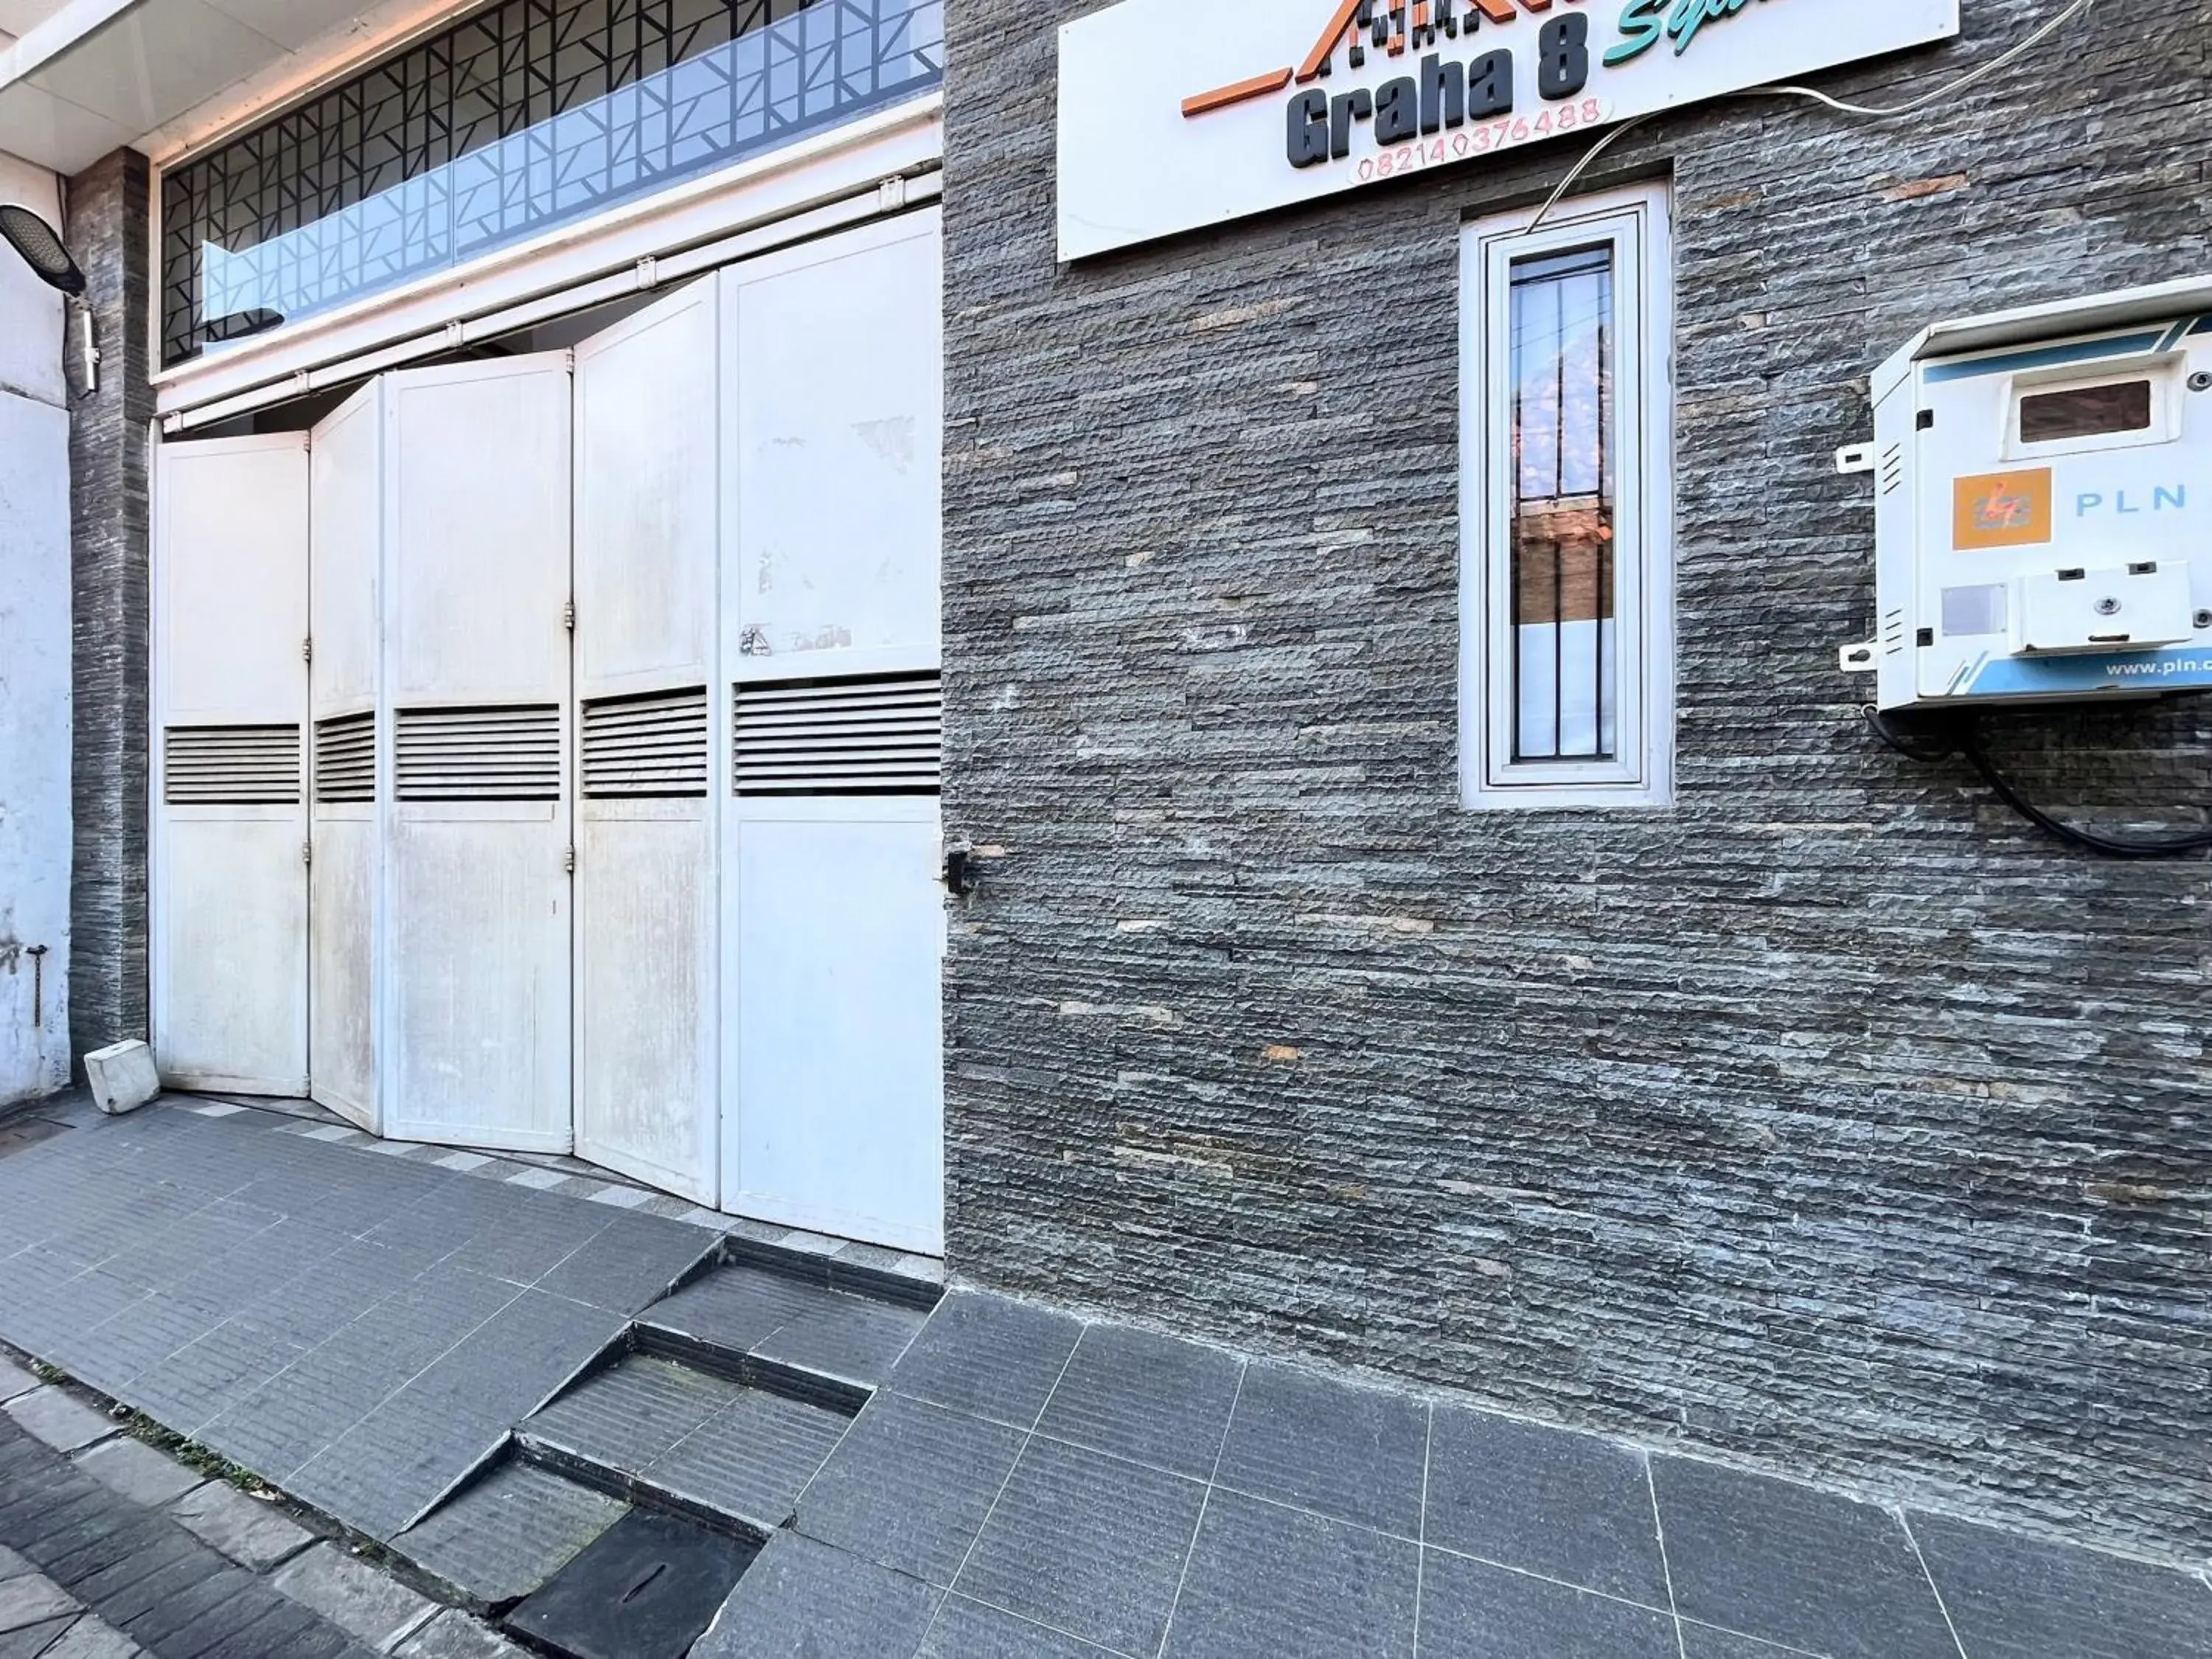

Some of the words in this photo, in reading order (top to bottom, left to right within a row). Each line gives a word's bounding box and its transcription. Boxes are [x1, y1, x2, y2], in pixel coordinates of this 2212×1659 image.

[1287, 48, 1514, 169] Graha
[1537, 11, 1590, 101] 8
[1357, 97, 1601, 181] 082140376488
[2076, 484, 2185, 517] PLN
